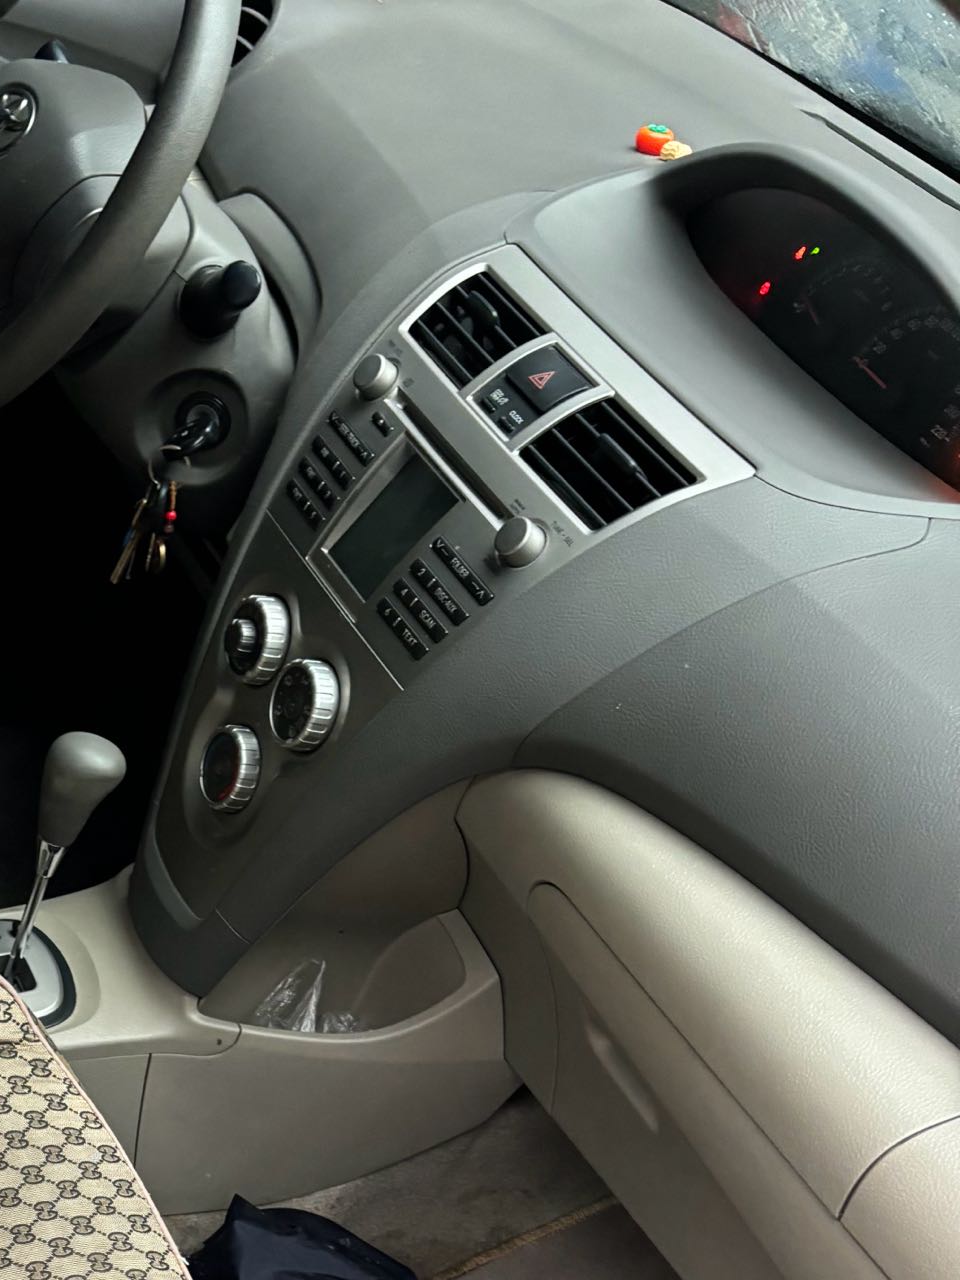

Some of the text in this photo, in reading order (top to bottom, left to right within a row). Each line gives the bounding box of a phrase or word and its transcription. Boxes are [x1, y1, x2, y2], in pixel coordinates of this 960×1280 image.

[508, 410, 525, 425] CLOCK
[418, 609, 438, 630] SCAN
[401, 627, 419, 647] TEXT
